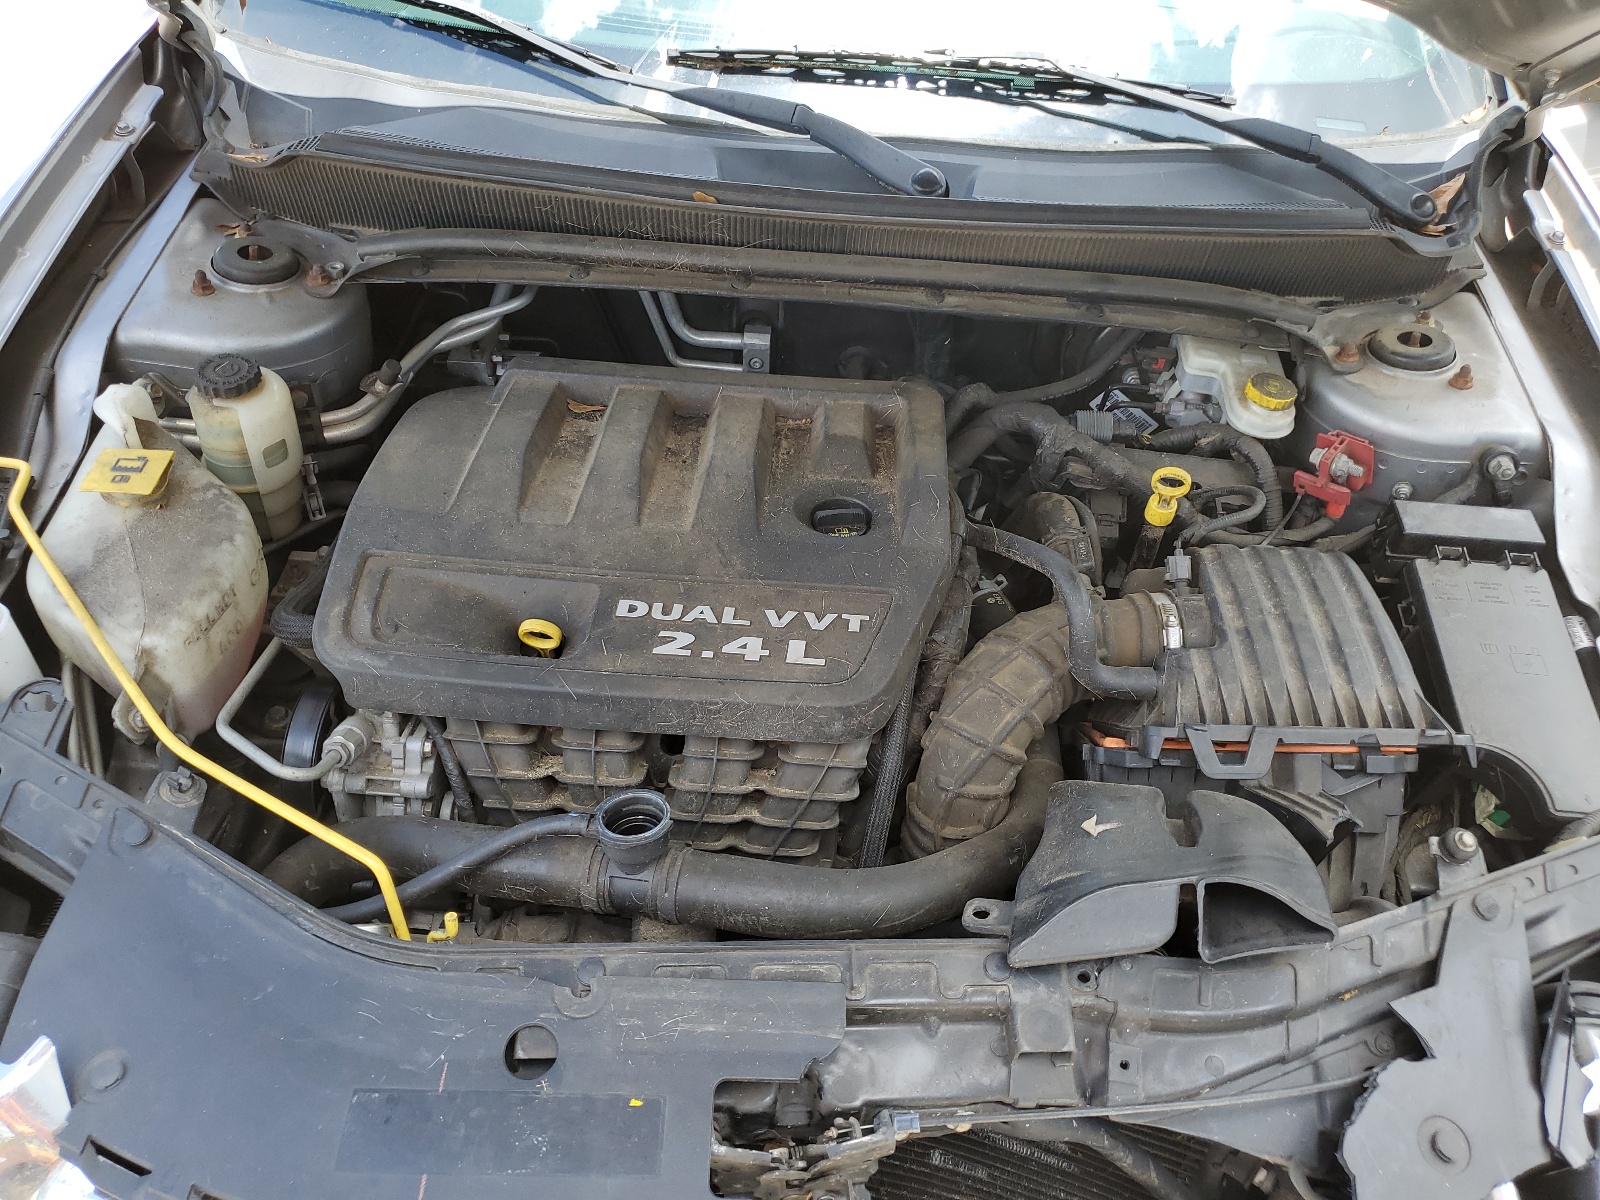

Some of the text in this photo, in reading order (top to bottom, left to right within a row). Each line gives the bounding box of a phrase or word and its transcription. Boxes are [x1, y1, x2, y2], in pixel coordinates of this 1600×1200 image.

[615, 599, 870, 633] DUAL VVT
[652, 630, 826, 666] 2.4 L
